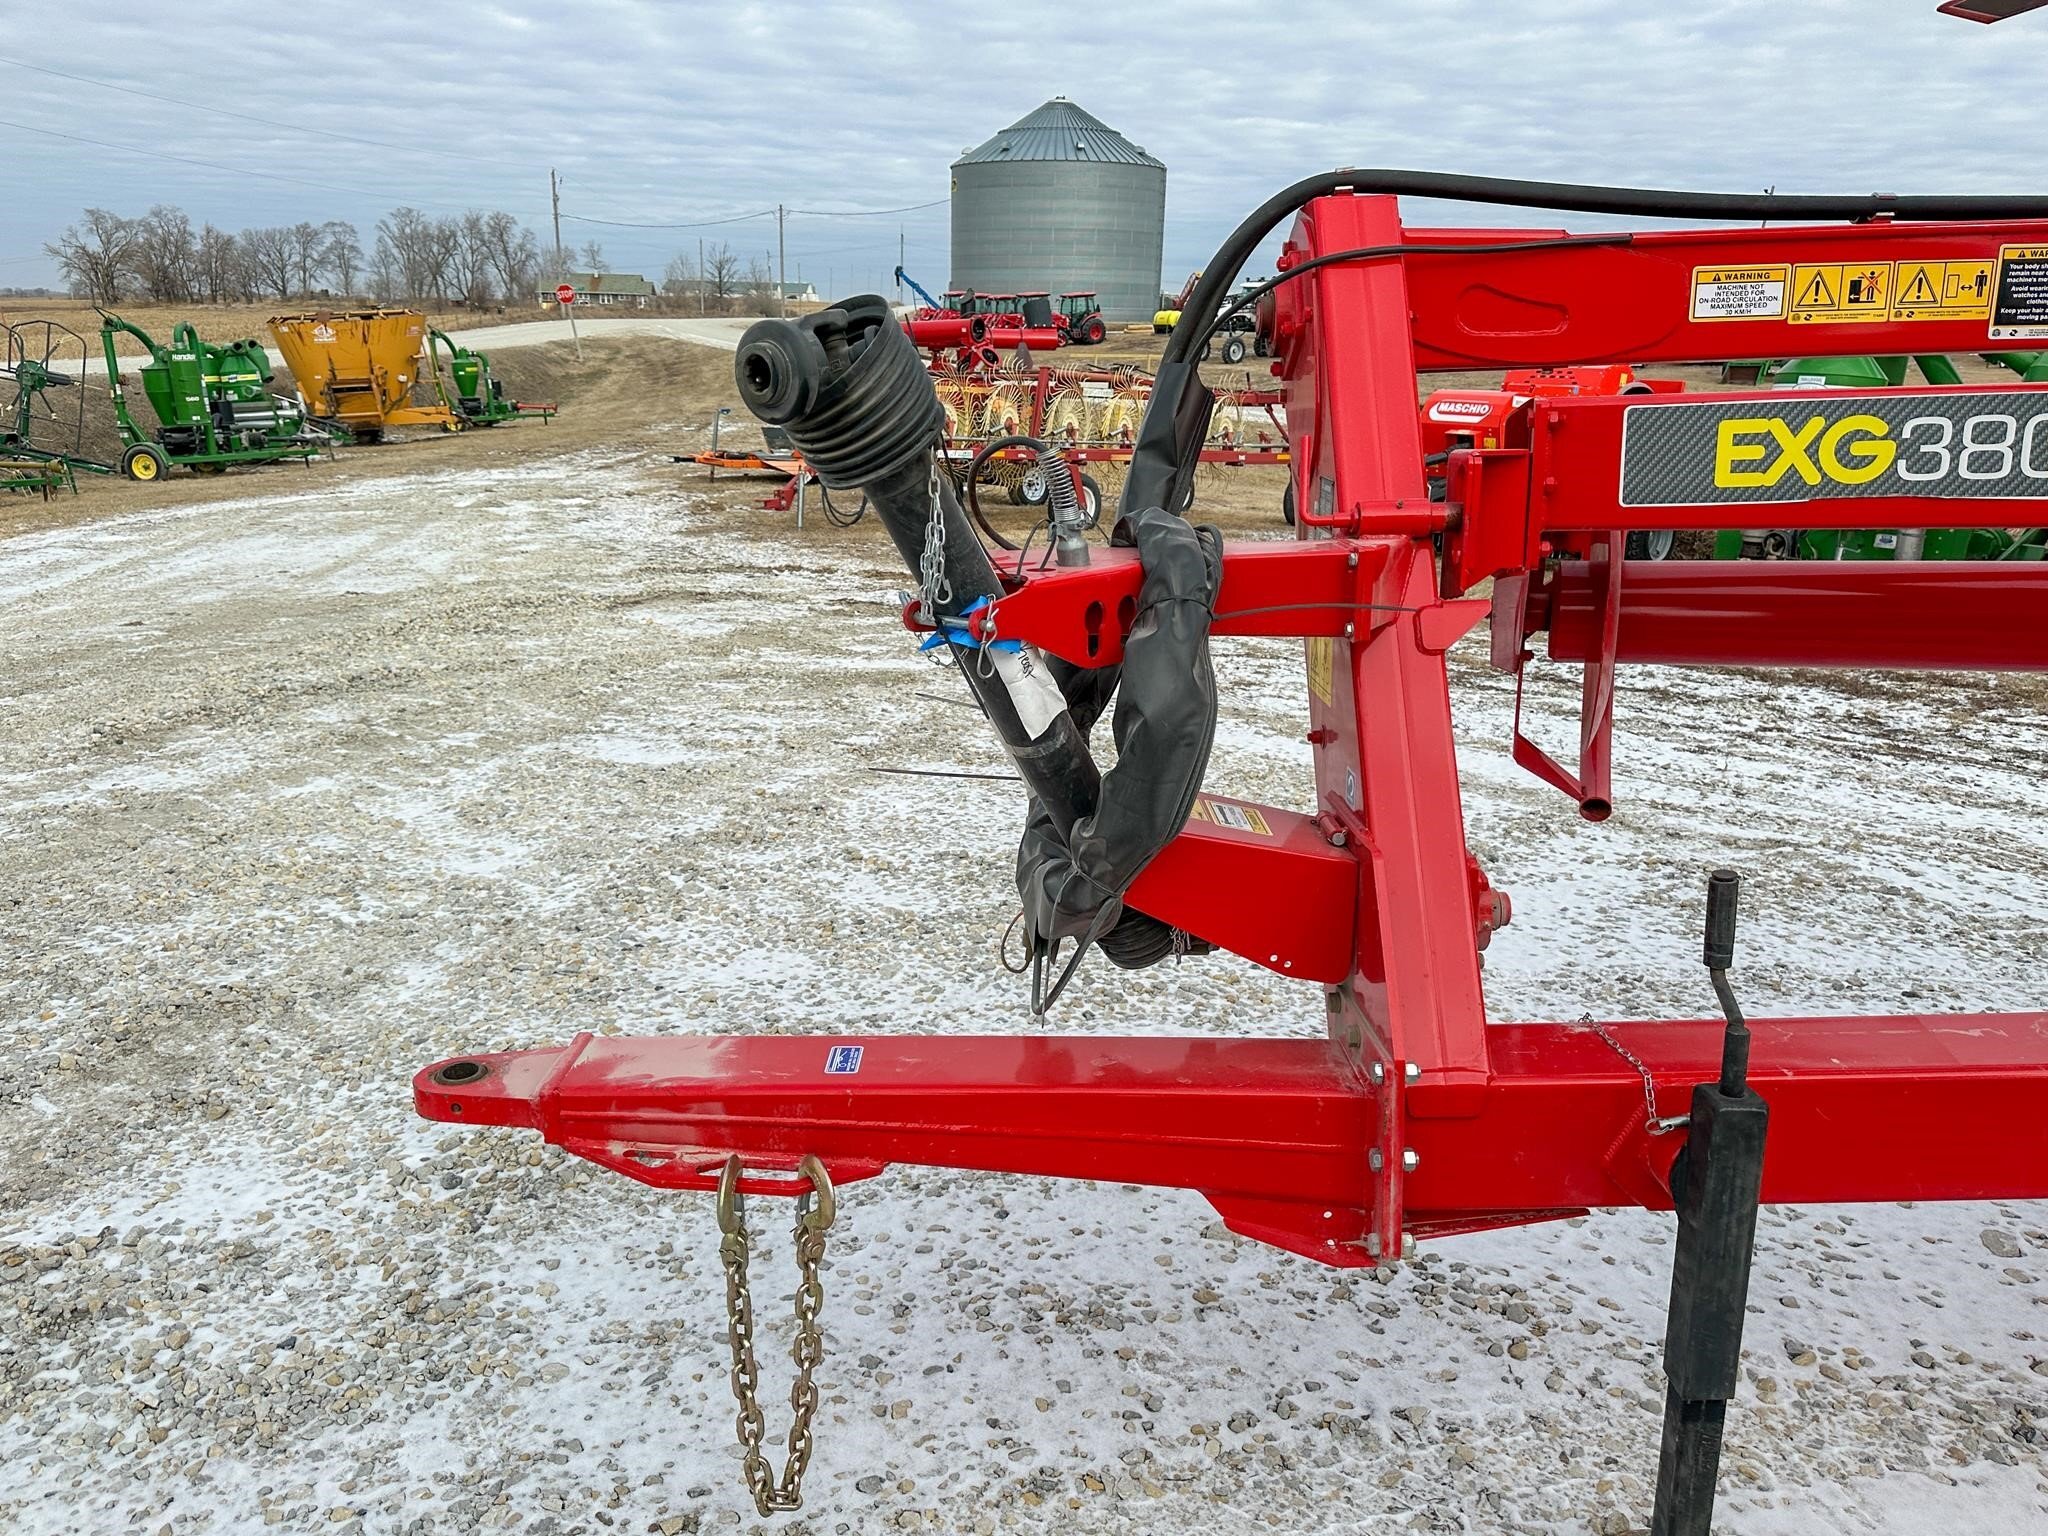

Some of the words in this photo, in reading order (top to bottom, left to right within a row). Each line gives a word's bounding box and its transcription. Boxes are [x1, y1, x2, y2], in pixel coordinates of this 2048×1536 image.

[1725, 272, 1770, 280] WARNING
[556, 289, 573, 299] STOP
[1438, 402, 1490, 414] MASCHIO
